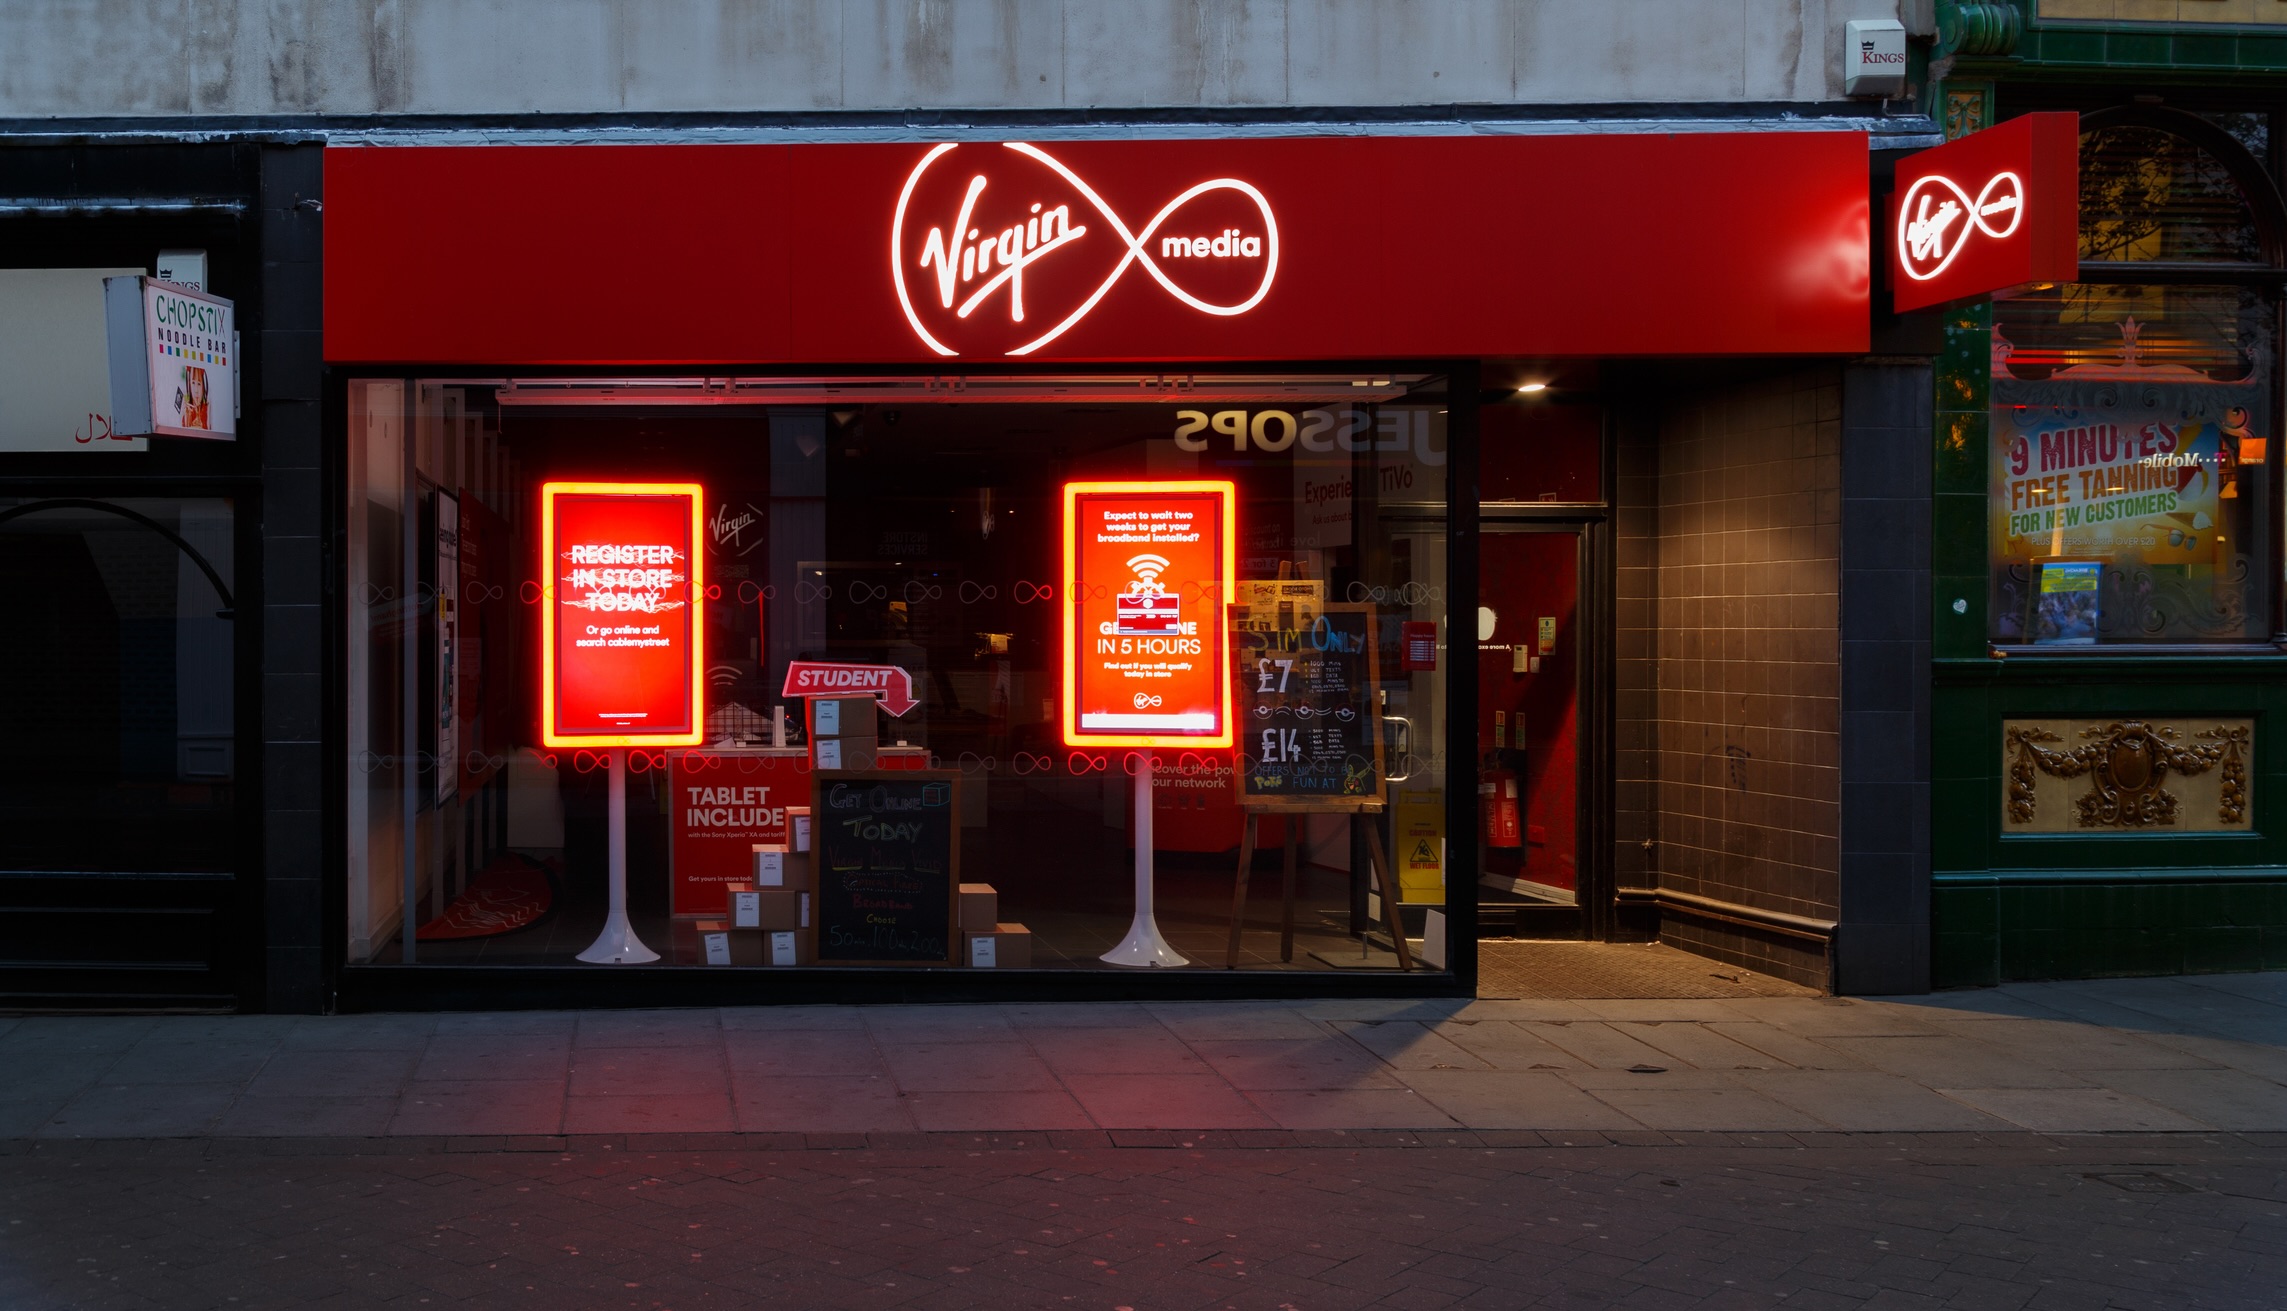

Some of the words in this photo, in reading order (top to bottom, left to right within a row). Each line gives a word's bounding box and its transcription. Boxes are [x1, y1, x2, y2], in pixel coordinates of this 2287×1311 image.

[1862, 51, 1904, 64] KINGS
[920, 175, 1087, 322] Virgin
[1162, 229, 1261, 258] media
[156, 295, 226, 339] CHOPSTIX
[158, 327, 201, 349] NOODLE
[208, 338, 226, 354] BAR
[2011, 437, 2029, 476] 9
[2040, 418, 2178, 472] MINUTES
[2011, 473, 2070, 511] FREE
[2078, 461, 2177, 500] TANNING
[1104, 511, 1136, 521] Expect
[1138, 511, 1149, 520] to
[1151, 511, 1172, 520] wait
[1174, 512, 1193, 520] two
[1312, 513, 1323, 525] Ask
[1331, 511, 1348, 523] about
[2010, 509, 2041, 536] FOR
[2046, 505, 2081, 531] NEW
[2086, 491, 2177, 524] CUSTOMERS
[709, 503, 756, 547] Virgin
[1106, 522, 1136, 531] weeks
[1138, 523, 1149, 531] to
[1150, 523, 1167, 534] get
[1169, 523, 1190, 534] your
[1097, 533, 1150, 542] broadband
[1152, 533, 1199, 542] installed?
[2032, 537, 2050, 546] PLUS
[2052, 537, 2081, 546] OFFERS
[2083, 537, 2113, 546] WORTH
[2116, 537, 2138, 546] OVER
[572, 545, 674, 565] REGISTER
[573, 568, 595, 588] IN
[602, 568, 672, 588] STORE
[585, 592, 659, 612] TODAY
[586, 625, 599, 635] Or
[600, 627, 612, 638] go
[614, 625, 640, 635] online
[642, 625, 659, 635] and
[1099, 622, 1119, 636] GE
[1311, 615, 1366, 654] ONLY
[576, 637, 606, 647] search
[608, 637, 670, 648] cablemystreet
[1097, 638, 1115, 655] IN
[1120, 638, 1132, 655] 5
[1137, 638, 1201, 655] HOURS
[1104, 662, 1119, 670] Find
[1133, 662, 1139, 670] if
[1154, 662, 1166, 670] will
[1167, 662, 1192, 672] qualify
[1124, 670, 1144, 678] today
[1146, 670, 1152, 678] in
[797, 670, 893, 687] STUDENT
[1256, 657, 1294, 693] £7
[1261, 728, 1301, 763] £14
[1153, 765, 1189, 775] cover
[1190, 764, 1211, 775] the
[1254, 765, 1290, 777] OFFERS
[1297, 766, 1316, 777] NOT
[1324, 766, 1335, 775] TO
[1175, 777, 1226, 789] network
[1292, 776, 1317, 789] FUN
[1322, 777, 1337, 789] AT
[687, 787, 770, 805] TABLET
[829, 783, 862, 809] GET
[869, 784, 922, 813] ONLINE
[687, 808, 784, 827] INCLUDE
[711, 832, 726, 840] Sony
[842, 814, 923, 844] TODAY
[1409, 829, 1437, 837] CAUTION
[1409, 862, 1421, 870] WET
[1422, 862, 1439, 870] FLOOR
[866, 913, 897, 924] CHOOSE
